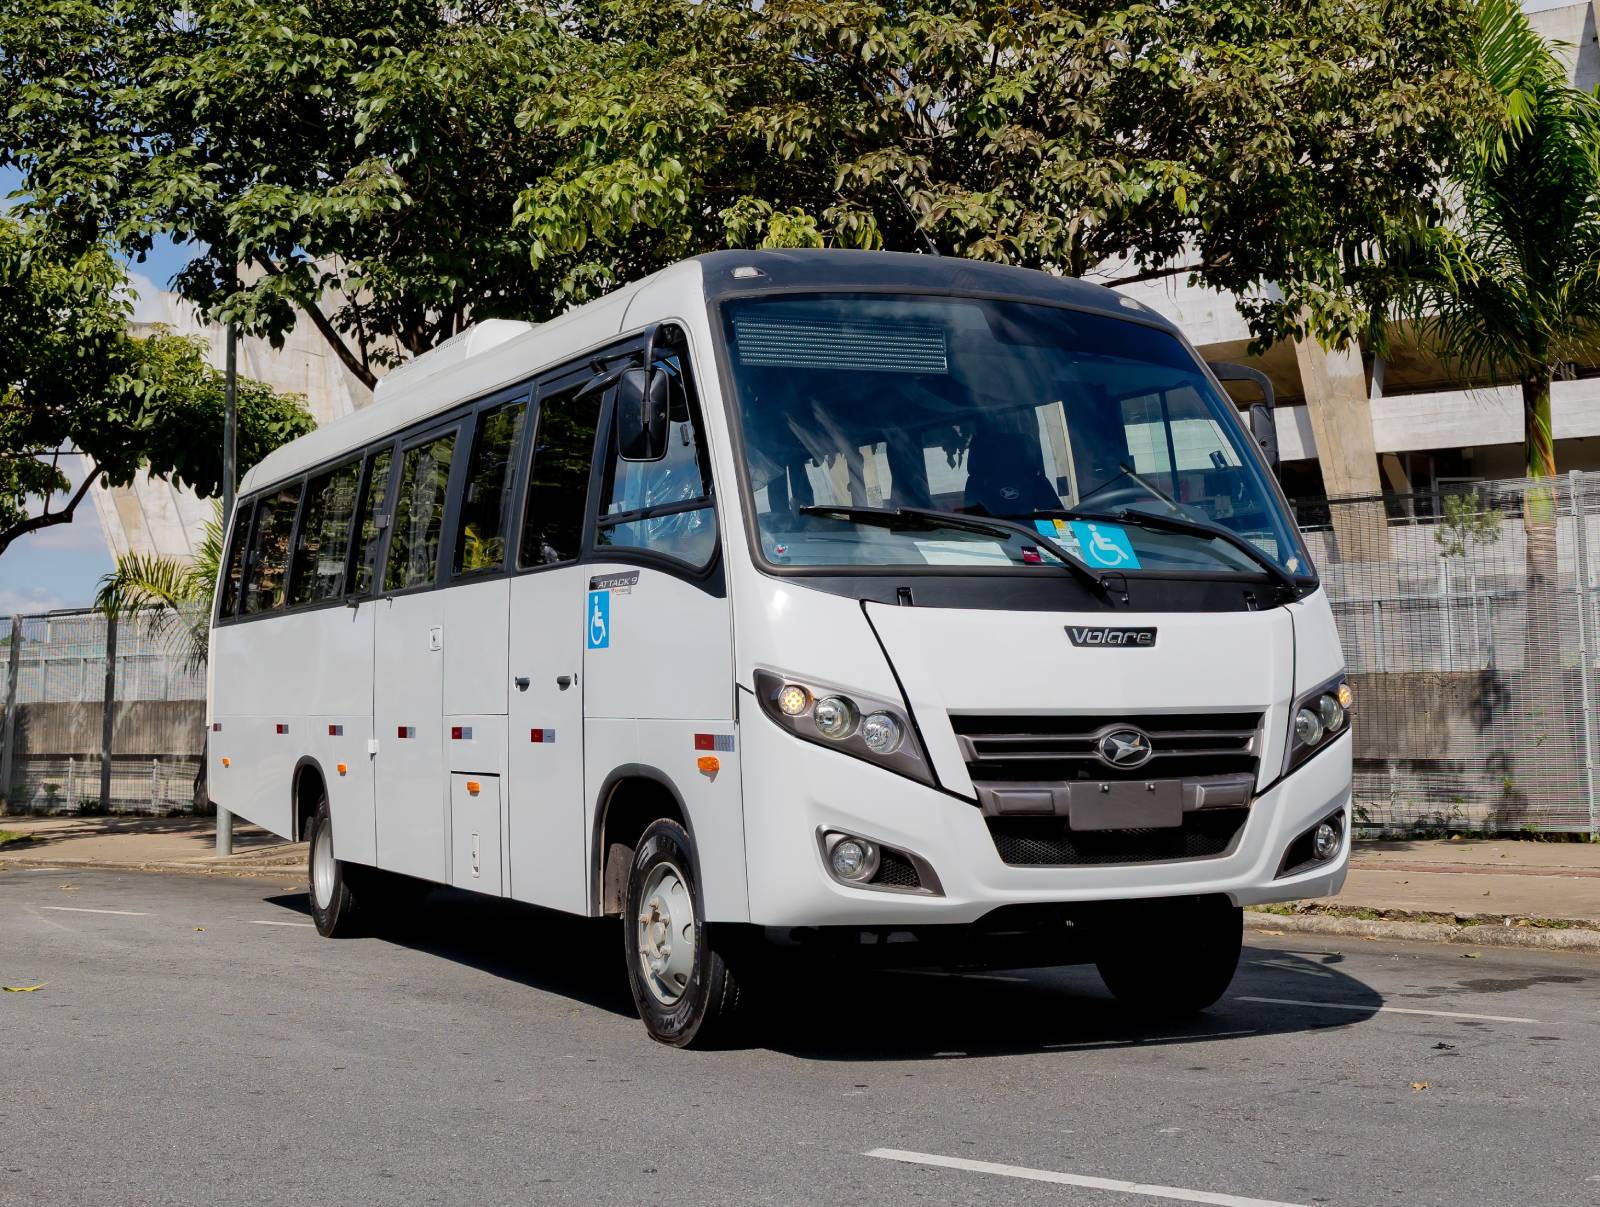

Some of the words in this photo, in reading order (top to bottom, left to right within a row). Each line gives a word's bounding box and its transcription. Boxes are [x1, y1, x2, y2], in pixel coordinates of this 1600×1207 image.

[598, 578, 631, 589] ATTACK
[631, 576, 638, 585] 9
[1072, 628, 1152, 644] Volare
